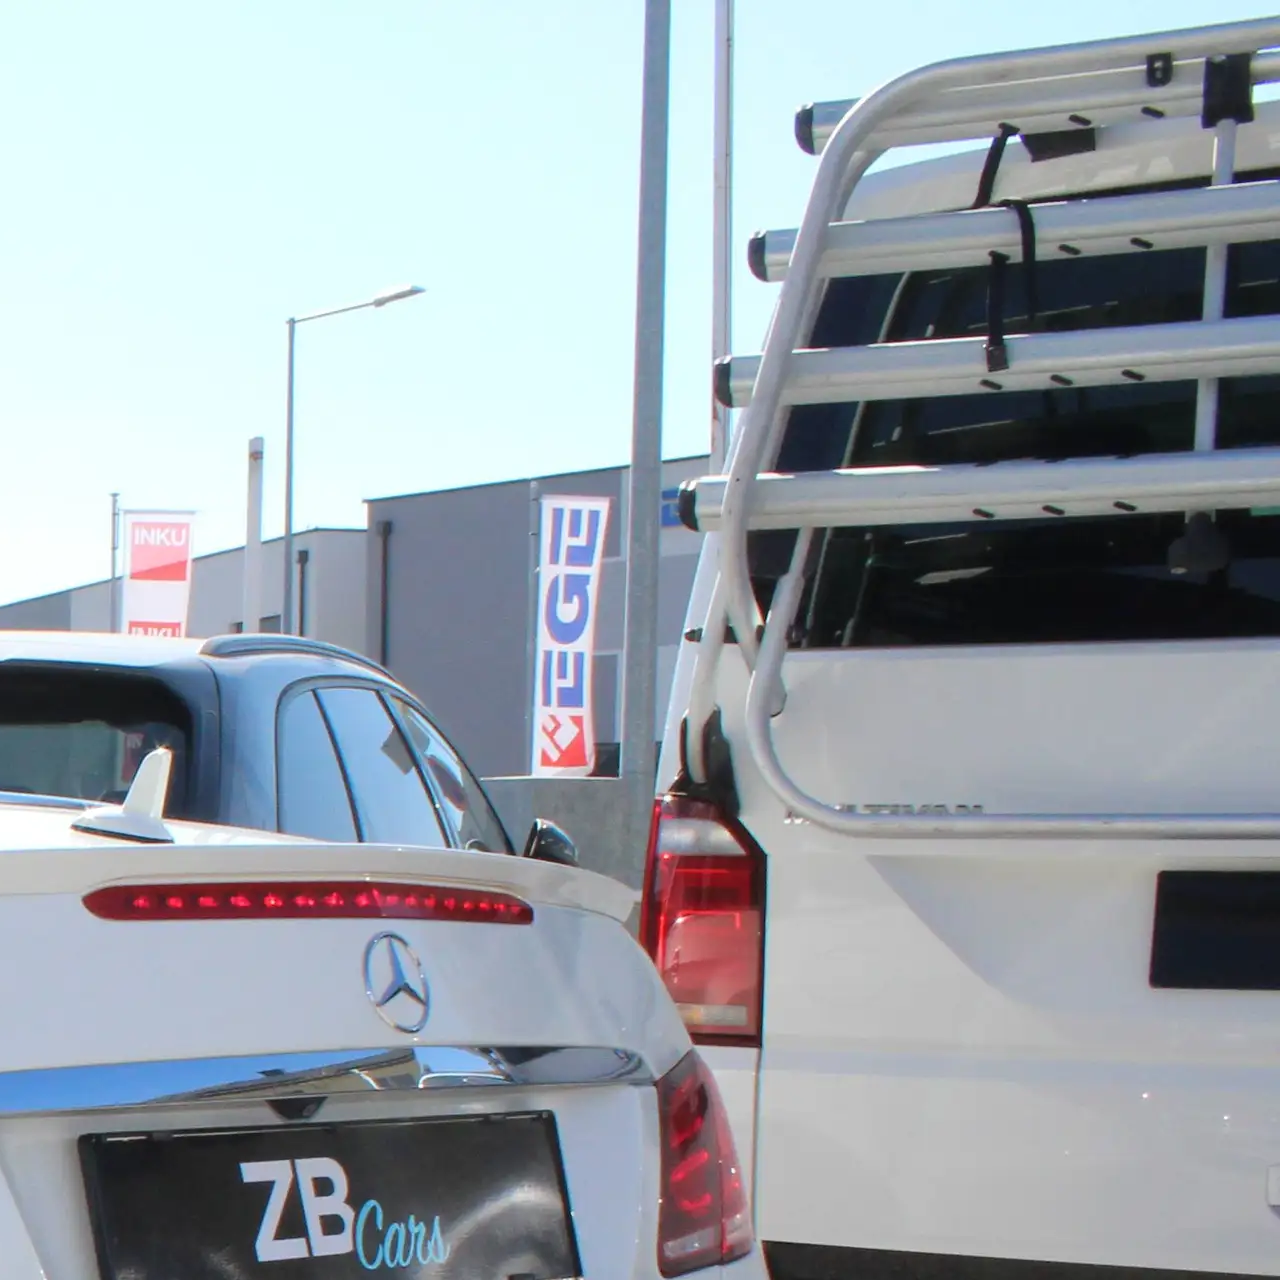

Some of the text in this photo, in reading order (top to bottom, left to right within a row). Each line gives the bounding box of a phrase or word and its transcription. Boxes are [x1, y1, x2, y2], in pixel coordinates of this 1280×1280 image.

[134, 527, 187, 546] INKU
[239, 1156, 451, 1271] ZB Cars
